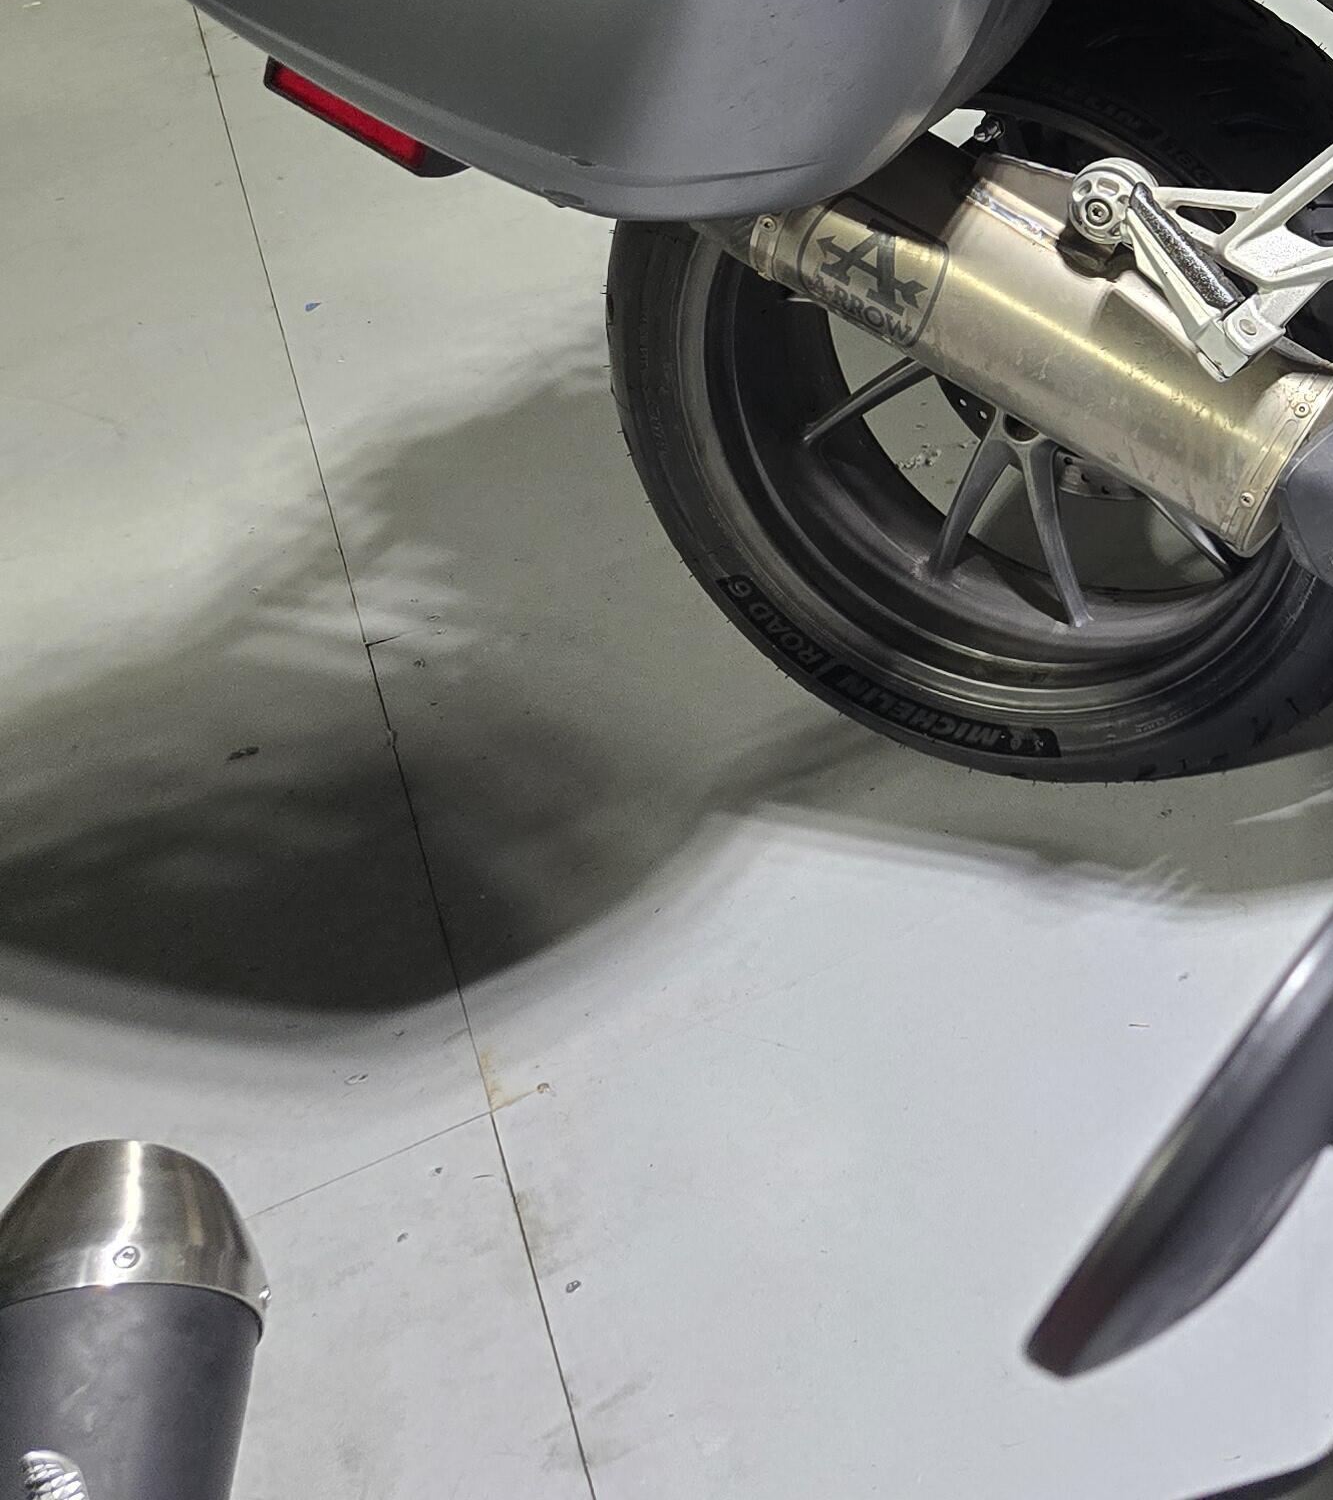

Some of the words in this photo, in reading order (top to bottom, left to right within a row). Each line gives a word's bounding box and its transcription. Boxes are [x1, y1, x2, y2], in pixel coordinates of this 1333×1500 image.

[807, 275, 913, 342] ARROW
[748, 602, 824, 668] ROAD
[838, 673, 1000, 746] MICHELIN
